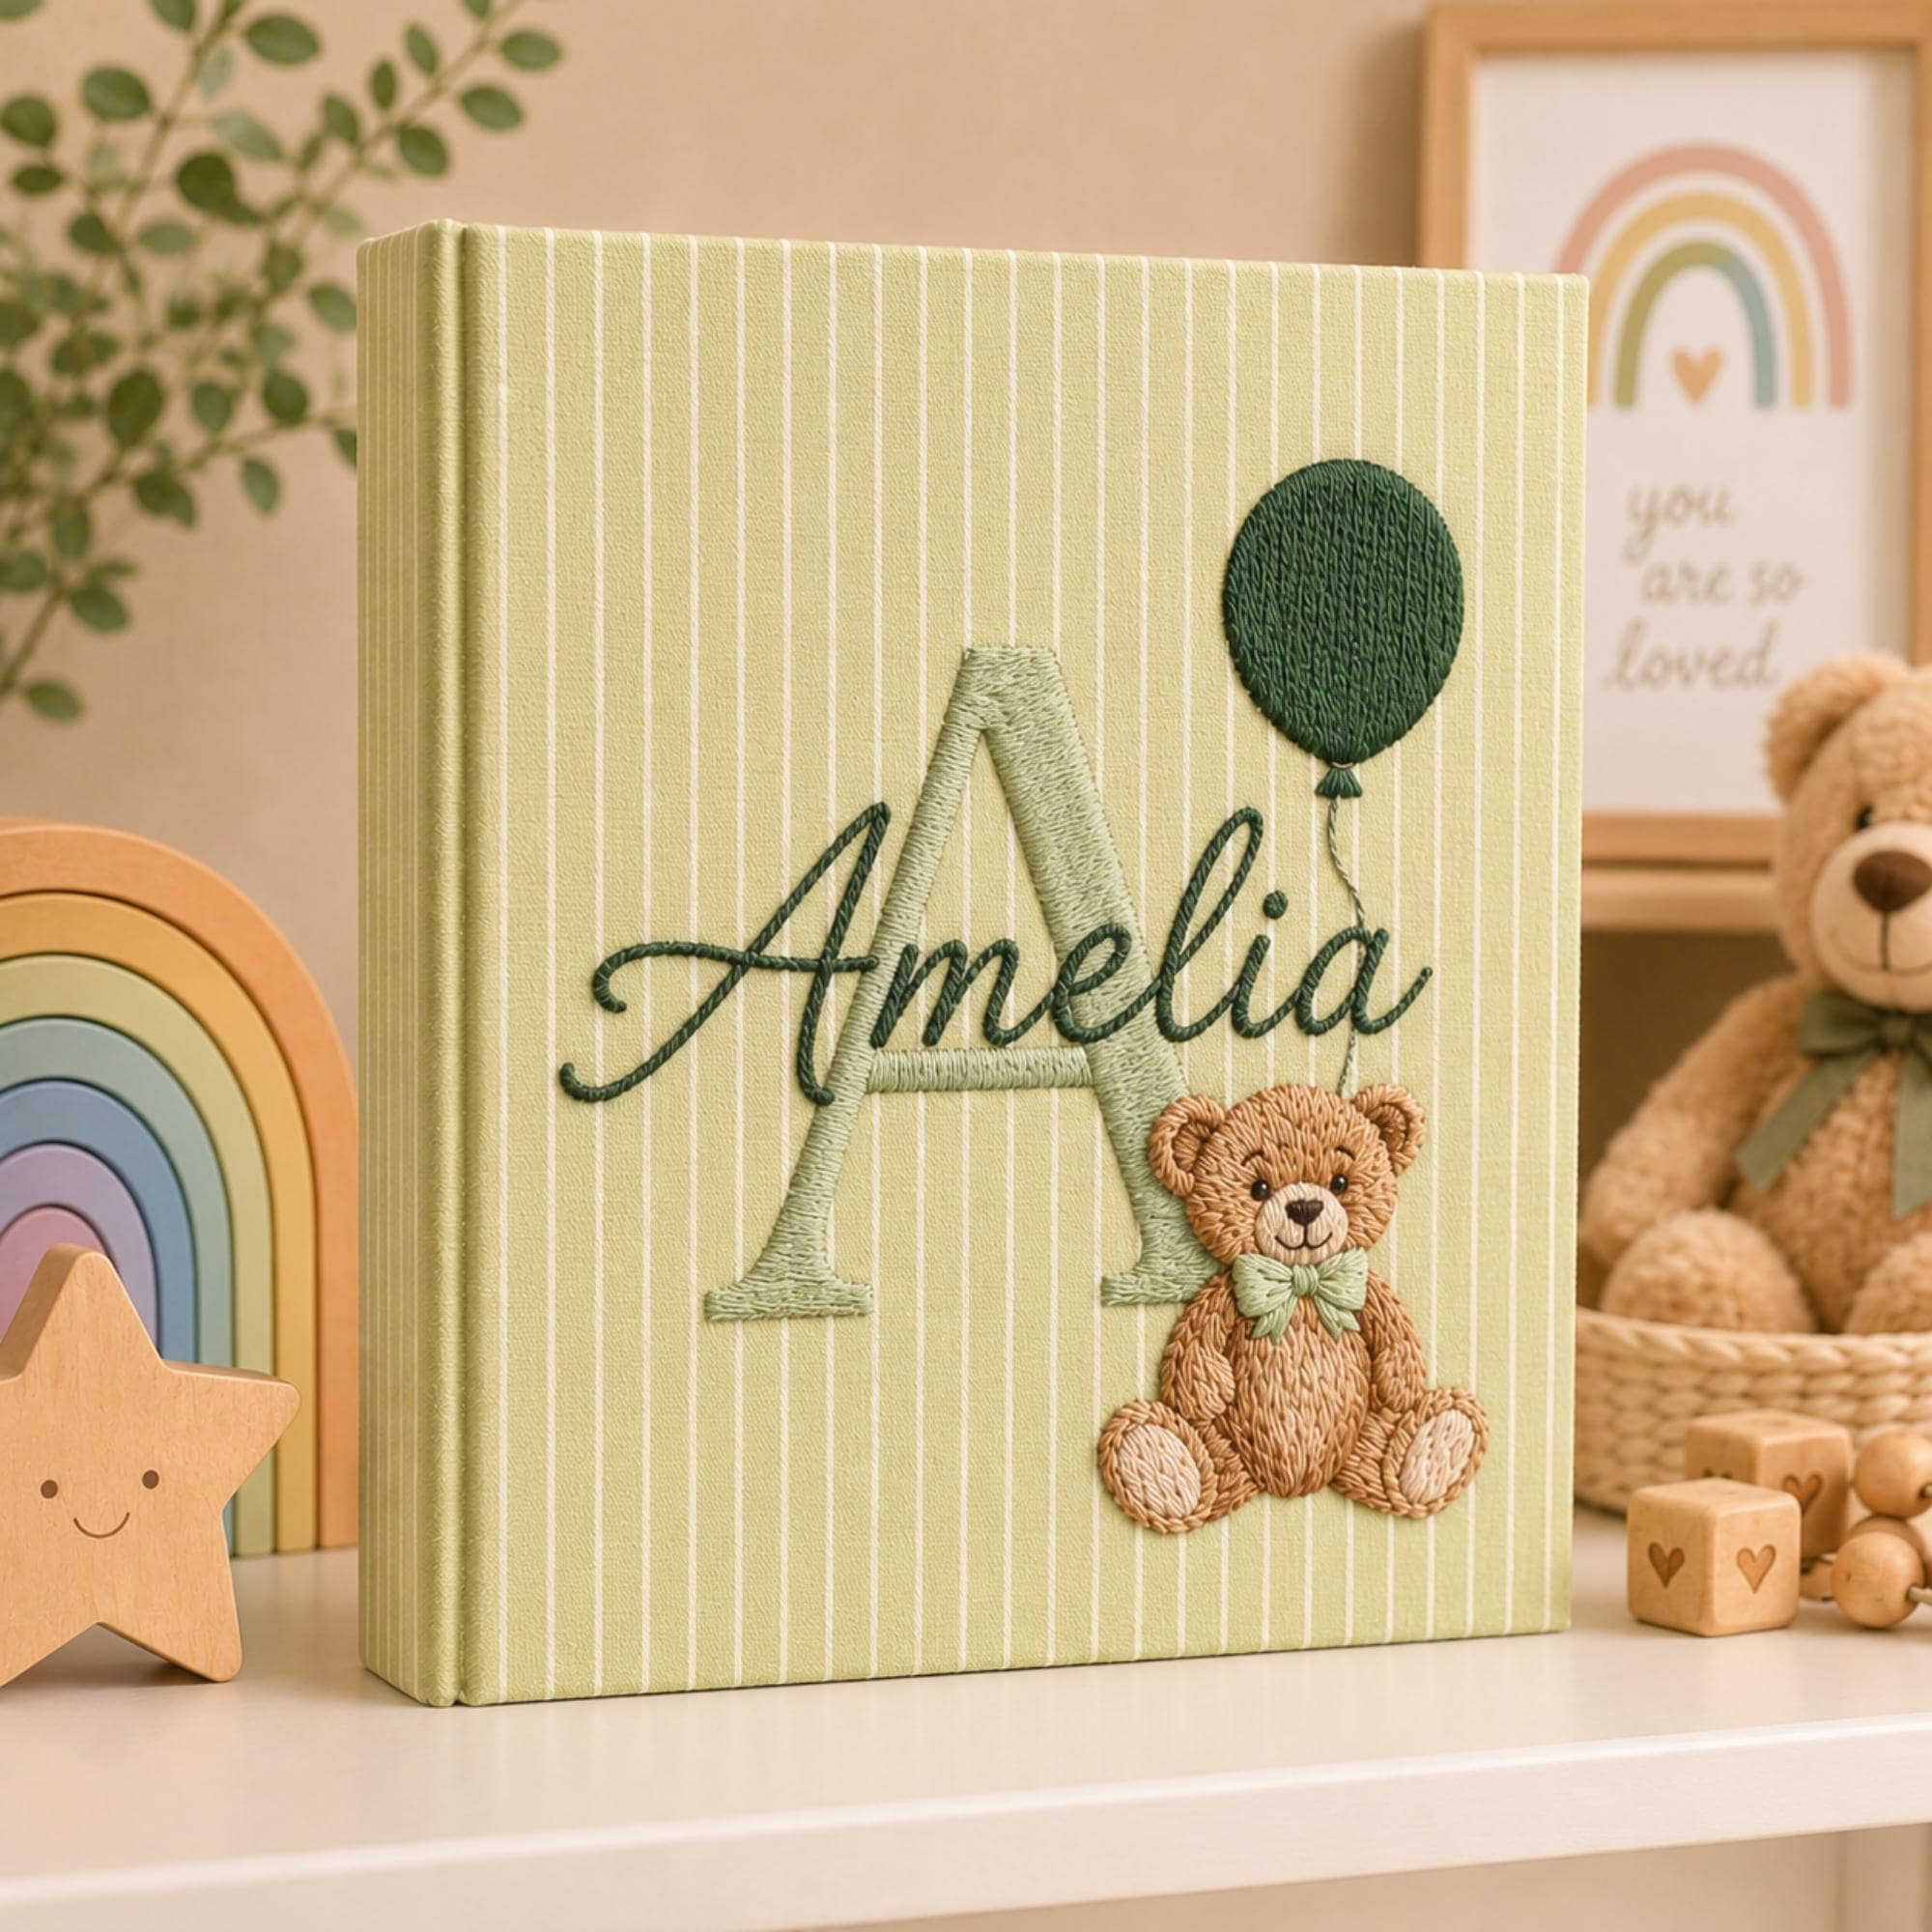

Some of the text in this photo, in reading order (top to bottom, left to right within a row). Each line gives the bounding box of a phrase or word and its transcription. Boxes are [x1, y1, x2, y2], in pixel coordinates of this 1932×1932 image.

[1623, 484, 1735, 564] you
[1641, 560, 1808, 606] are so
[1602, 616, 1782, 691] loved
[559, 801, 1433, 1105] Amelia
[704, 645, 1222, 1321] A
